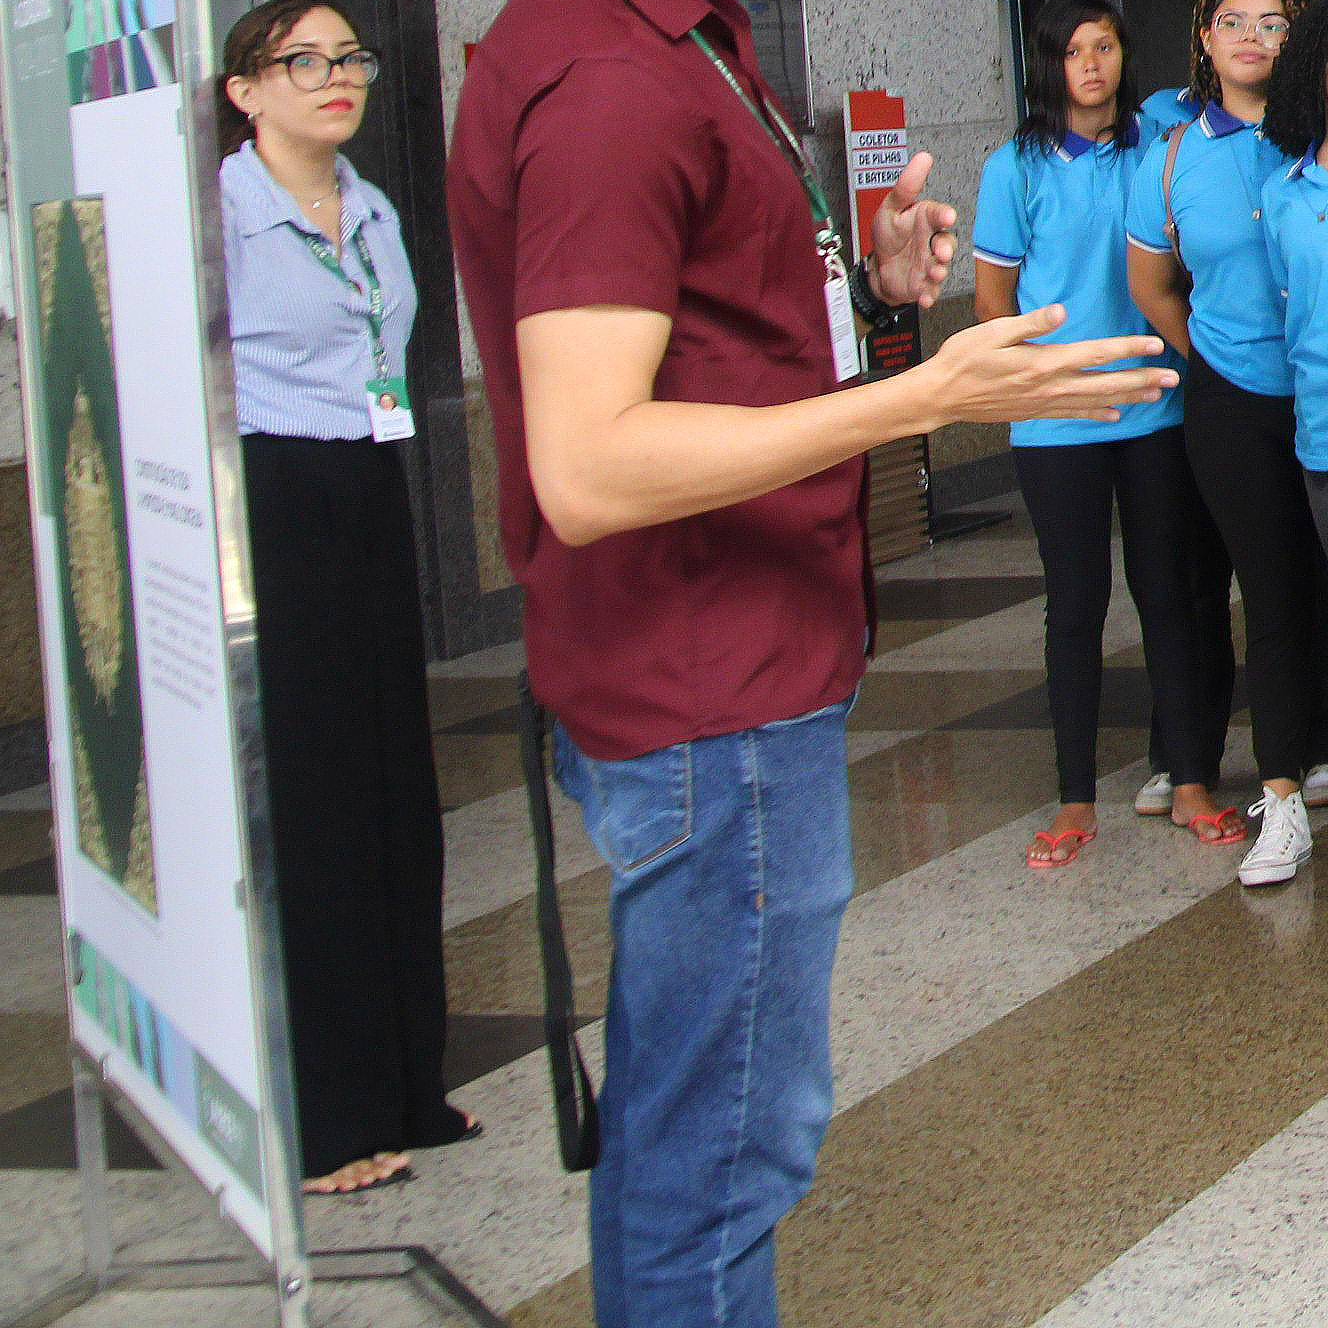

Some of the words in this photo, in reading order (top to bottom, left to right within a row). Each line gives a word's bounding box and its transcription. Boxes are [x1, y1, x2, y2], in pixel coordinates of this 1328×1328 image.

[858, 133, 899, 146] COLETOR
[859, 153, 871, 165] DE
[872, 151, 901, 164] PILHAS
[857, 172, 865, 184] E
